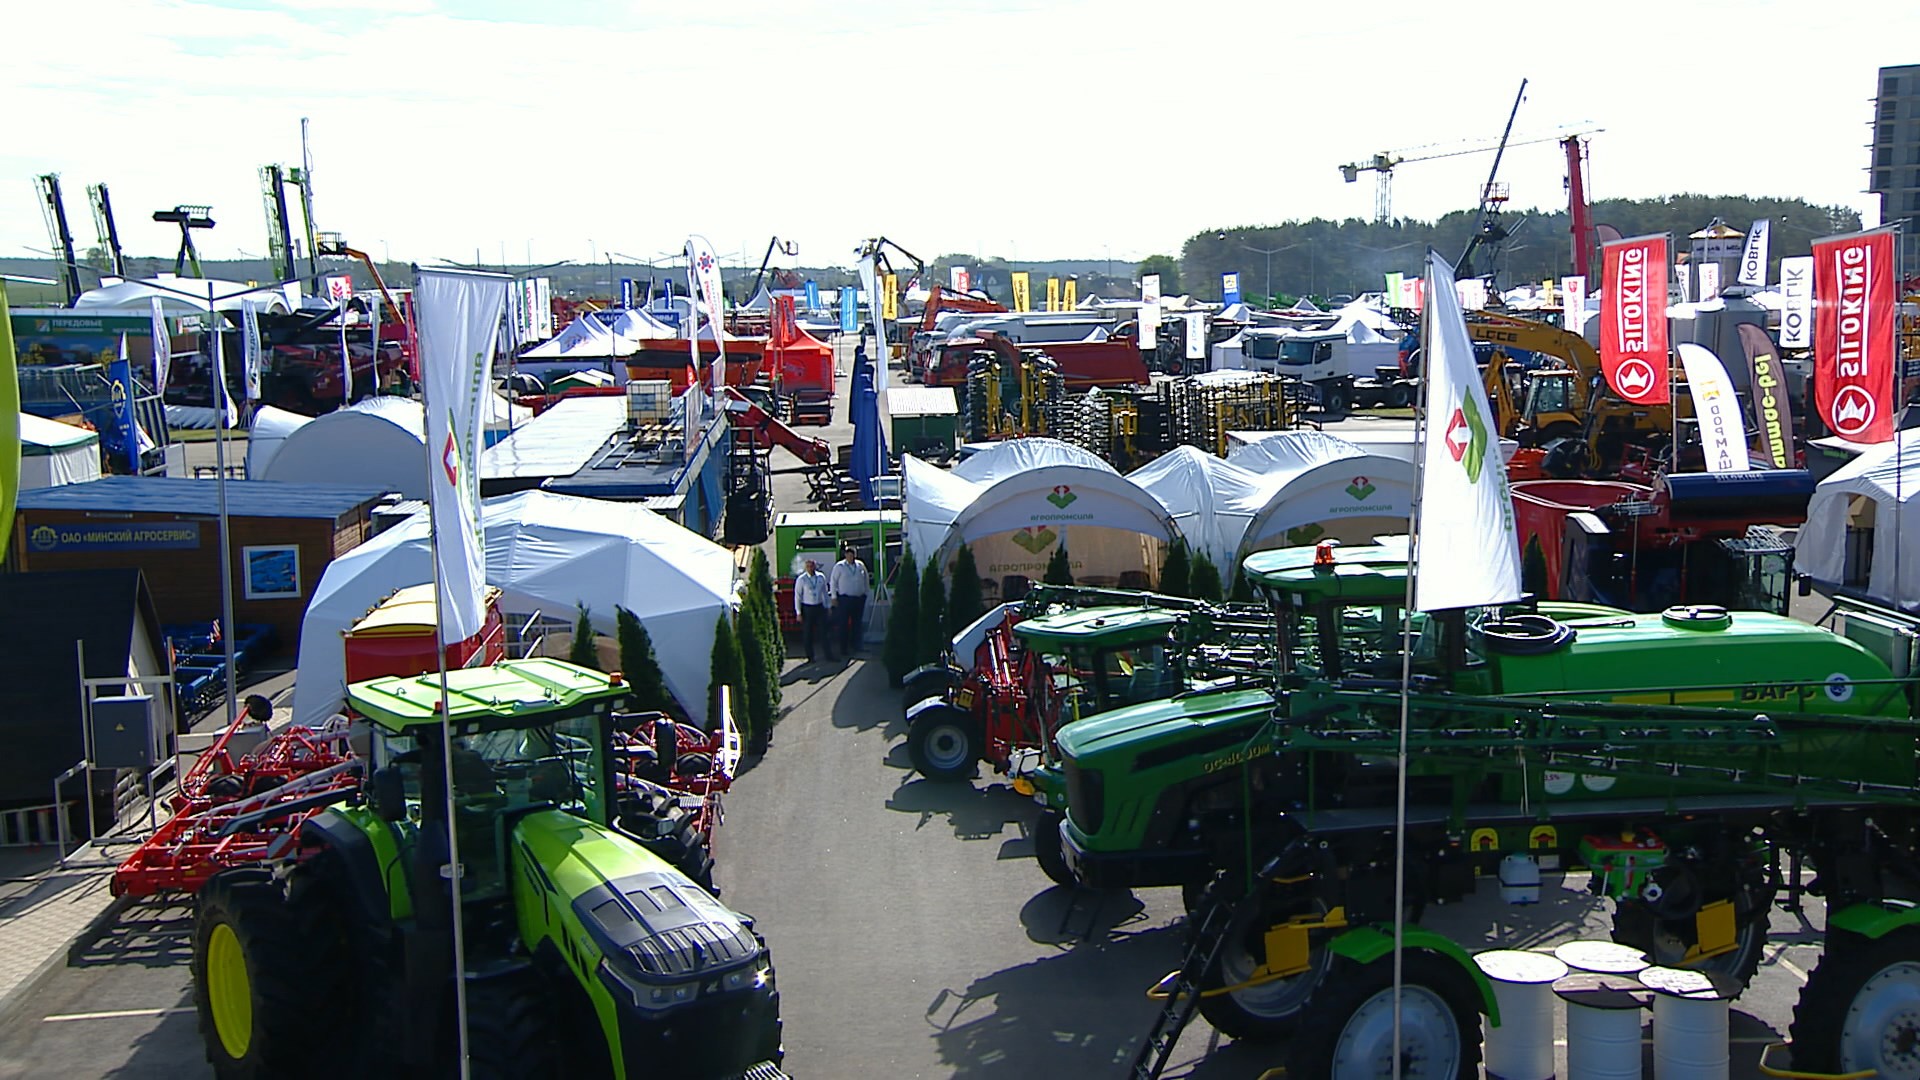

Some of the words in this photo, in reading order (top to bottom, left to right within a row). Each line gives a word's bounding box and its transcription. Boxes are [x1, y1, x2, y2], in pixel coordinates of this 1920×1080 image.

[52, 319, 103, 328] ПЕРЕДОВЫЕ
[1329, 504, 1393, 513] АГРОПРОМСИЛА
[1030, 513, 1094, 521] АГРОПРОМСИЛА
[61, 533, 81, 543] ОАО
[83, 529, 132, 543] «МИНСКИЙ
[134, 529, 196, 542] АГРОСЕРВИС»
[1740, 679, 1817, 701] БАРС
